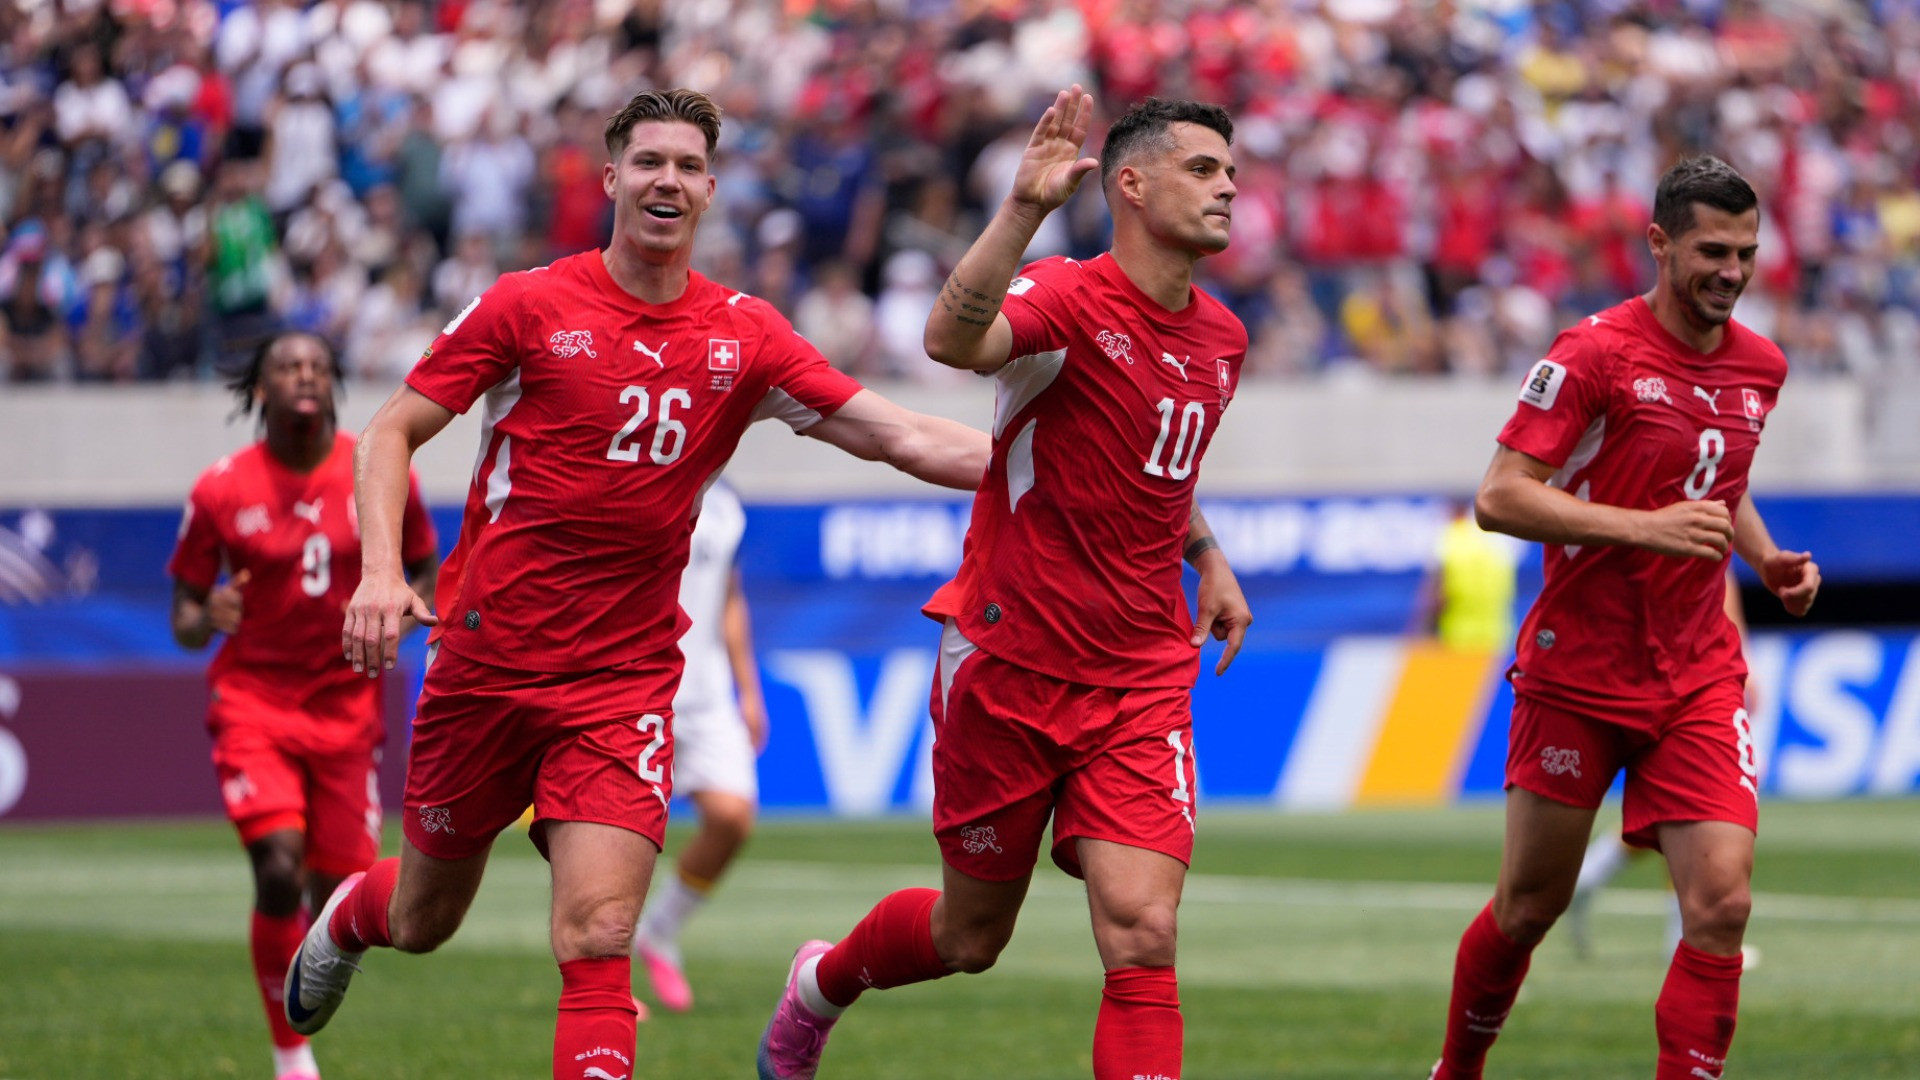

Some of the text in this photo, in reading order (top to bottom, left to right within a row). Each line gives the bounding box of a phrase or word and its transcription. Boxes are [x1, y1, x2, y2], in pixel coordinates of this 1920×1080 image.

[606, 385, 692, 465] 26
[1143, 397, 1205, 480] 10
[1683, 428, 1725, 500] 8
[301, 533, 331, 596] 9
[637, 713, 675, 784] 2
[1167, 731, 1197, 803] 1
[1733, 707, 1756, 777] 8
[574, 1046, 630, 1066] suisse
